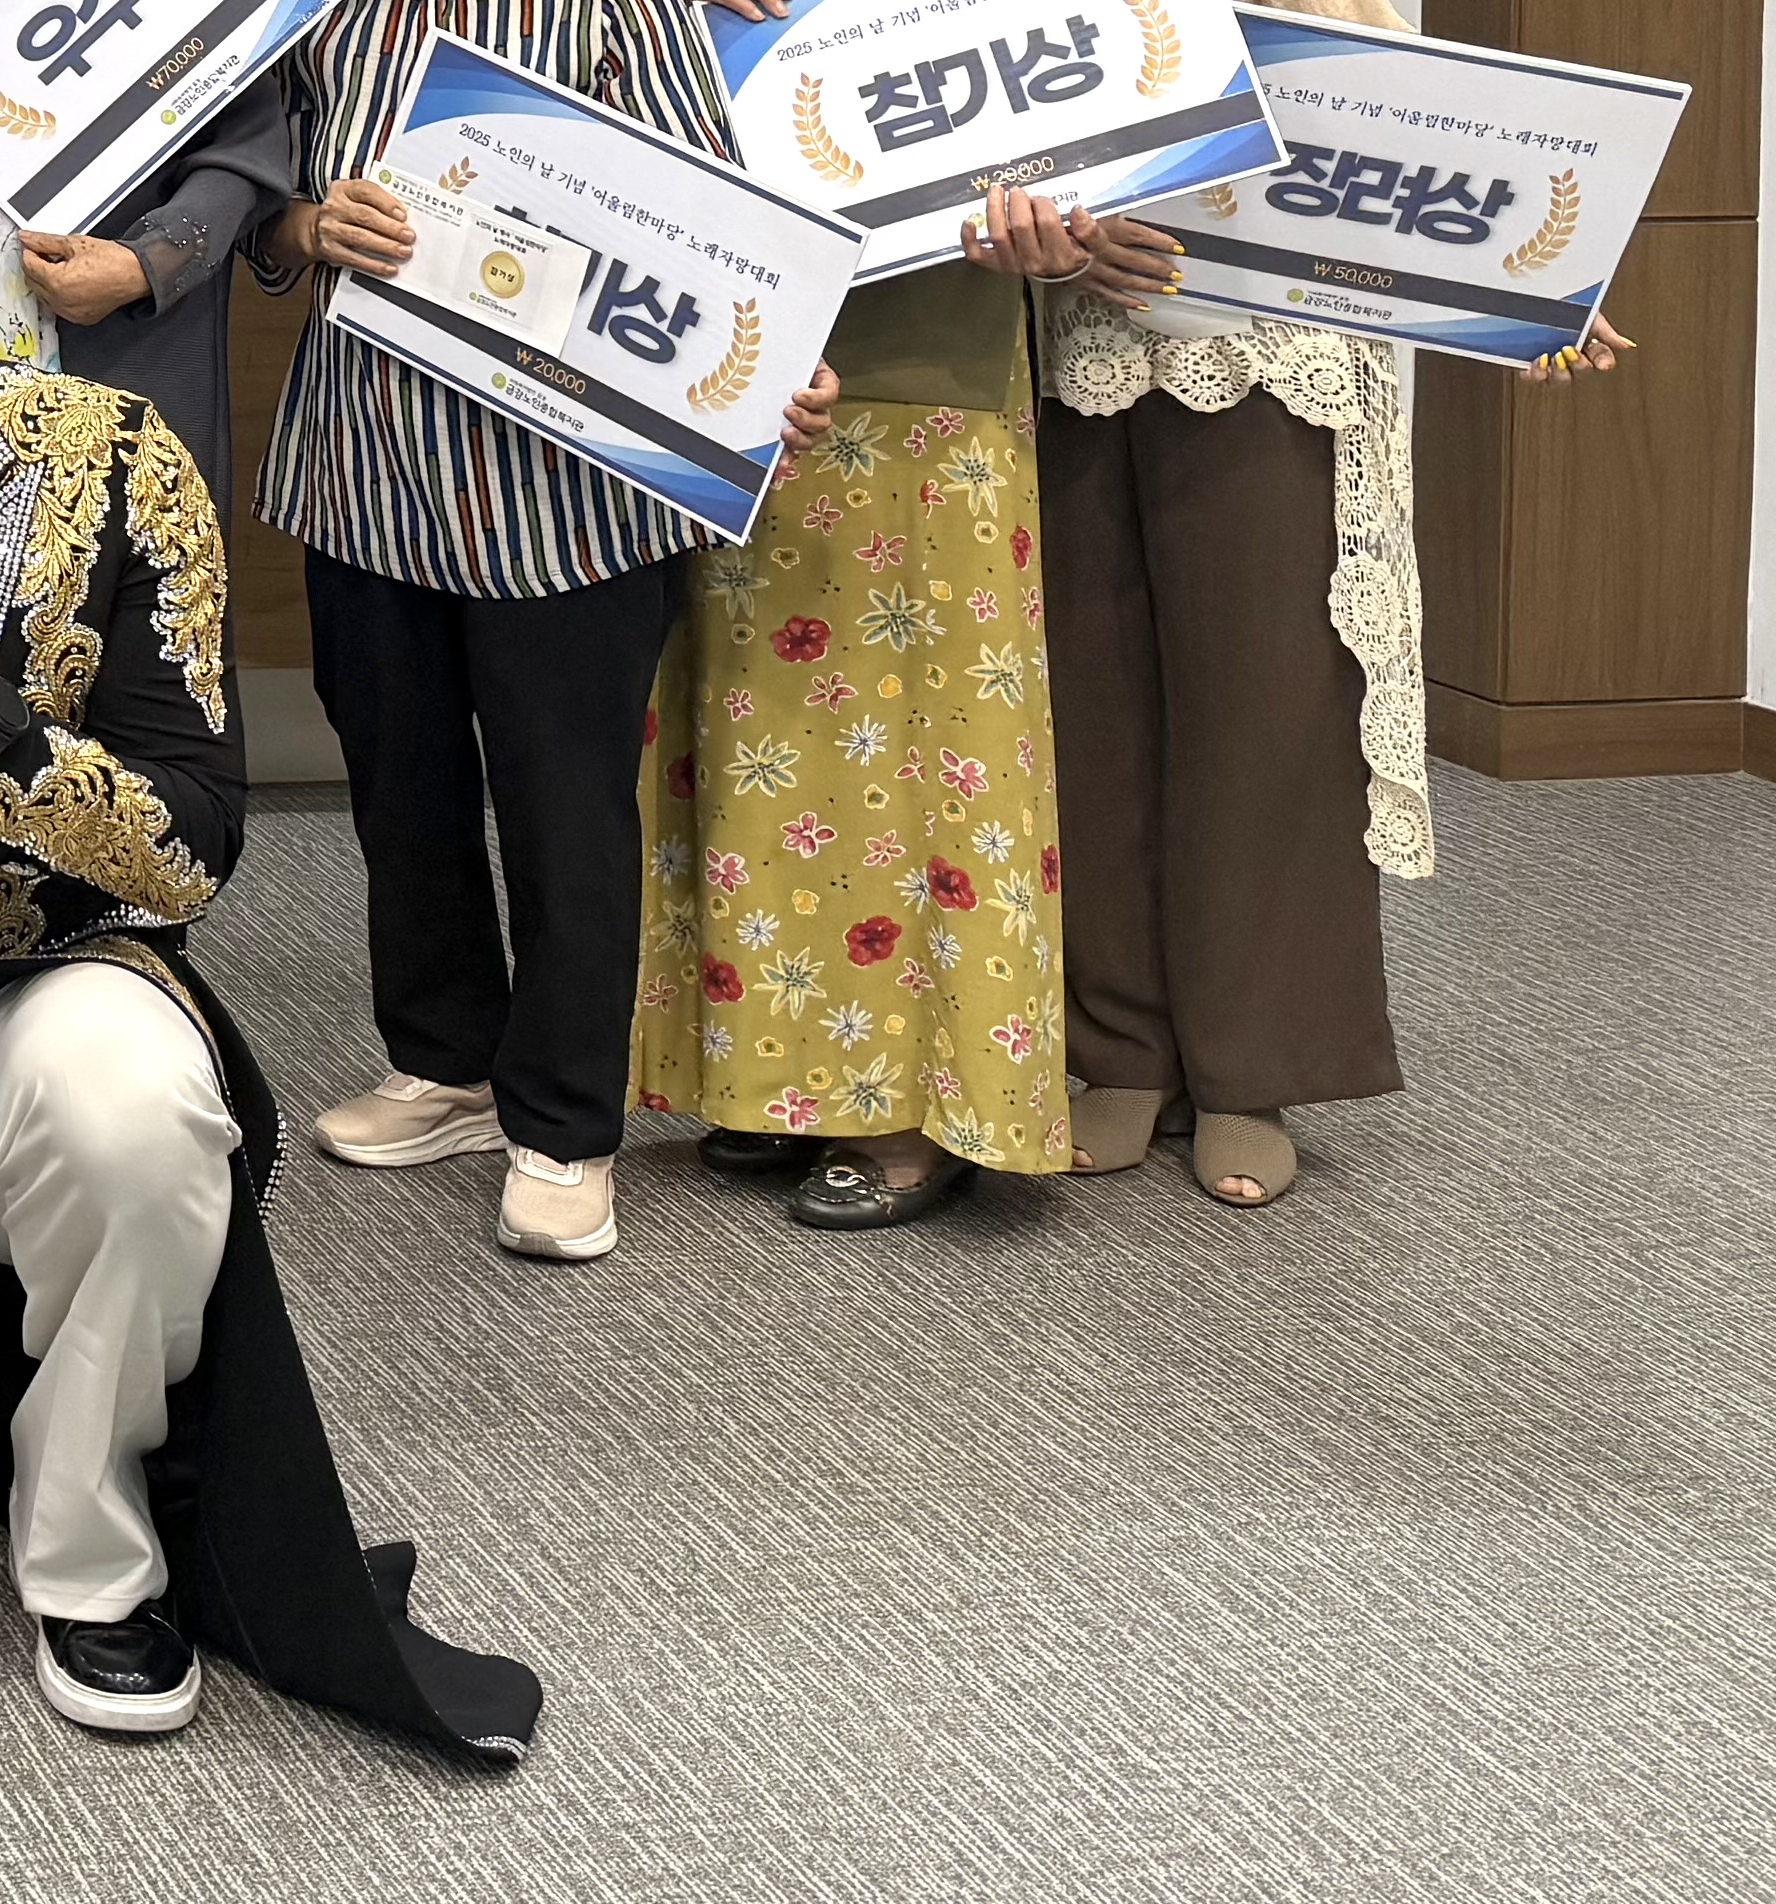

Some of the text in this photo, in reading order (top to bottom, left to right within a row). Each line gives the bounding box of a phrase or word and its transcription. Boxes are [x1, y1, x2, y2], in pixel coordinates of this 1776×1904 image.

[777, 41, 813, 62] 2025
[818, 24, 864, 51] 노인의
[858, 14, 1104, 153] 참가상
[459, 123, 492, 147] 2025
[492, 140, 536, 171] 노인의
[1263, 139, 1515, 246] 장려상
